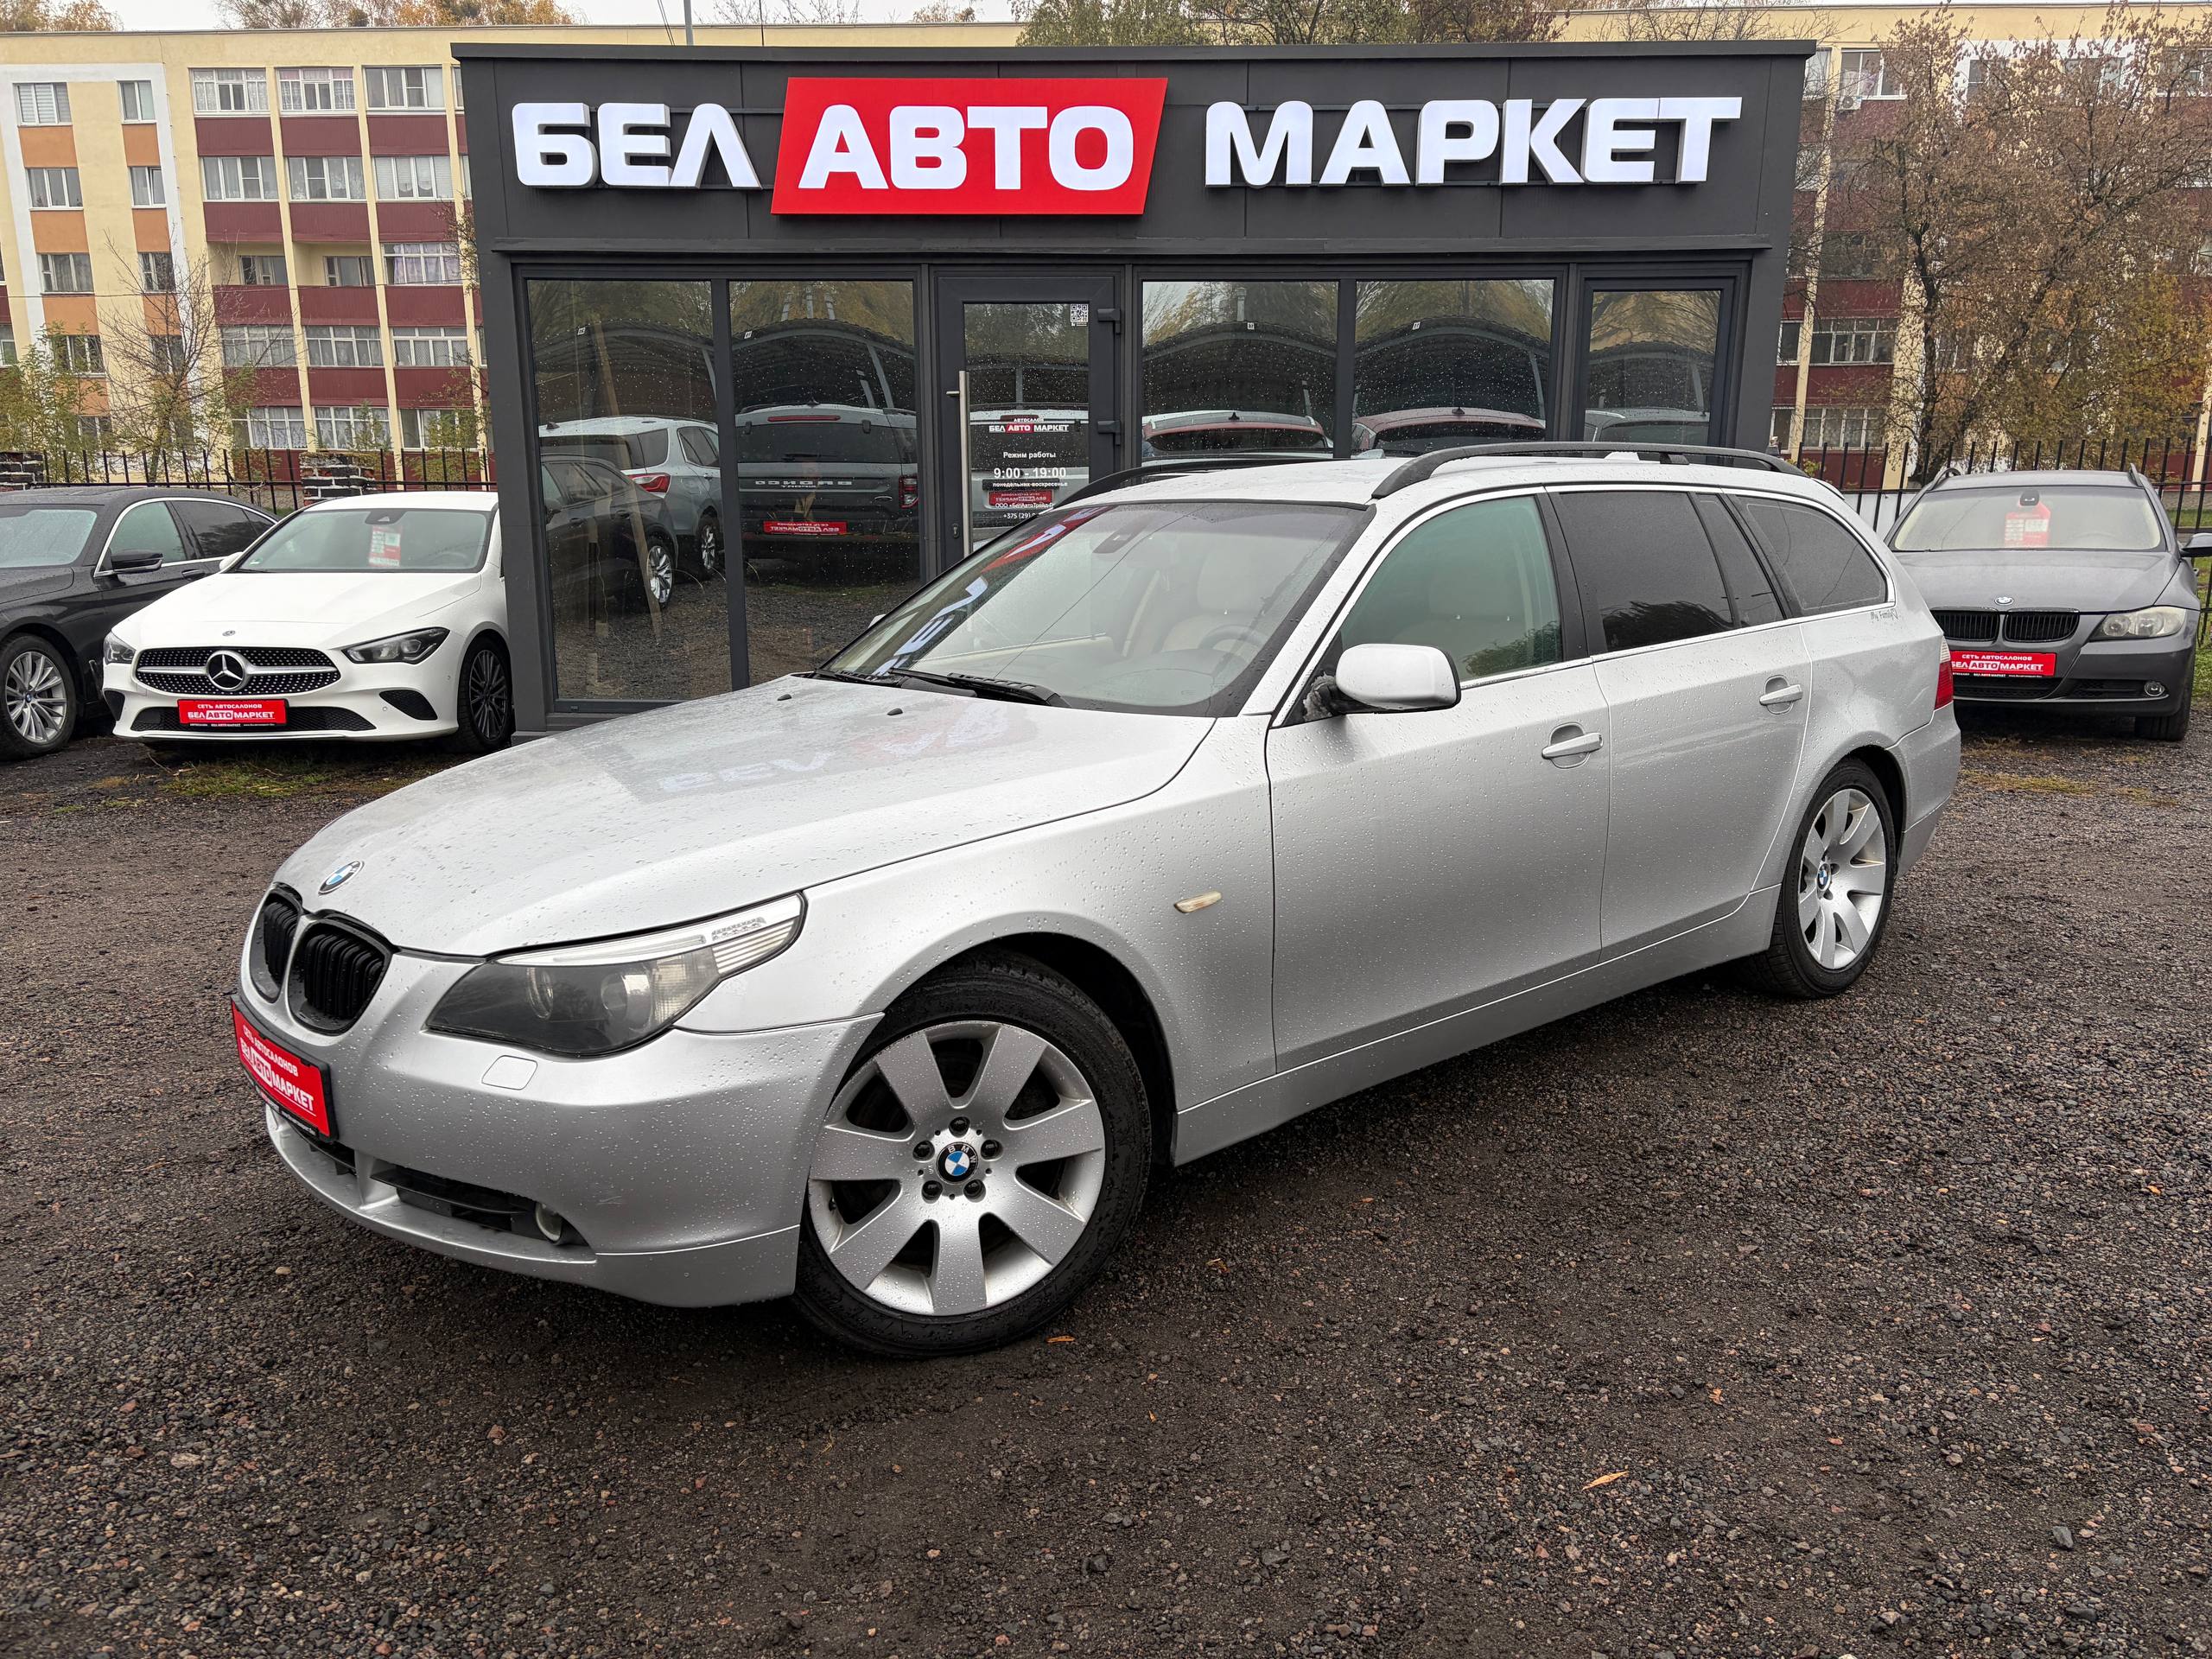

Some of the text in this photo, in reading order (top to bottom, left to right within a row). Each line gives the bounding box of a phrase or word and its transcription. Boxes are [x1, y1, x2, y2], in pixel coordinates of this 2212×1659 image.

[512, 97, 1742, 191] БЕЛ АВТО МАРКЕТ
[1029, 451, 1056, 460] работы
[994, 467, 1020, 479] 9:00
[1033, 467, 1066, 479] 19:00
[271, 1070, 315, 1111] МАРКЕТ
[947, 1145, 977, 1164] BMW
